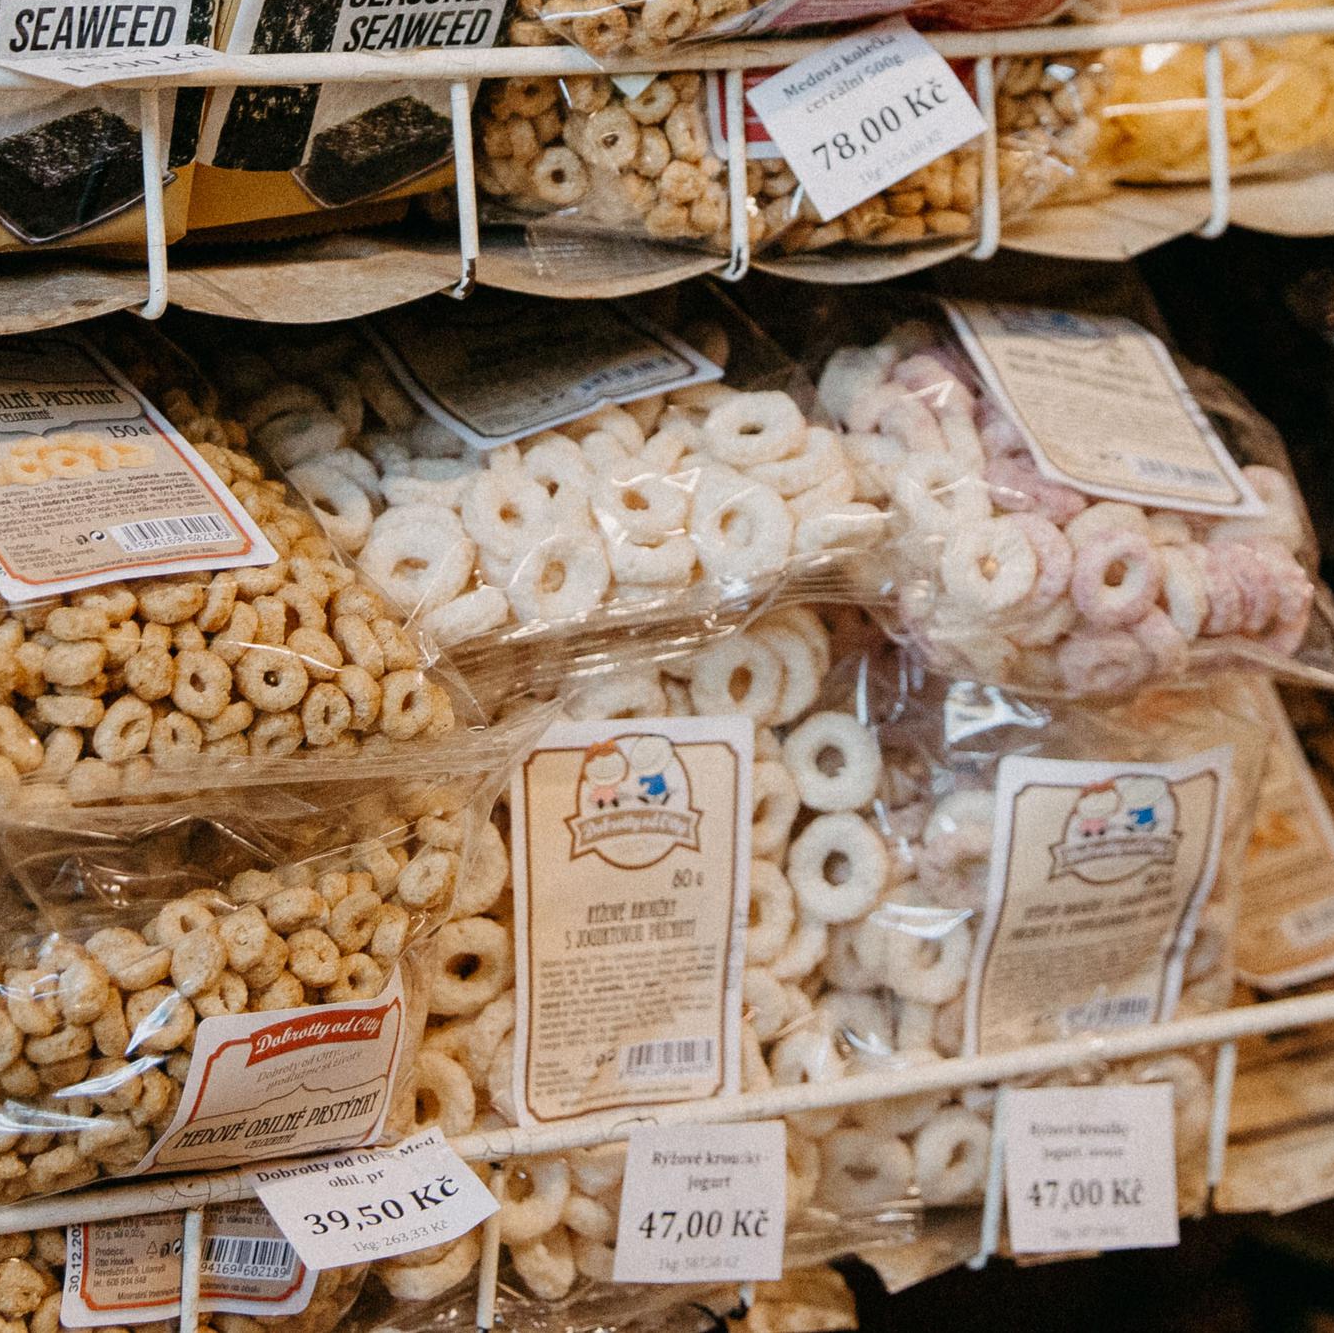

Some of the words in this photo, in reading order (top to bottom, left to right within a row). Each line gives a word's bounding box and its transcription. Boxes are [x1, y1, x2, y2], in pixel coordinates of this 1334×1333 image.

[8, 4, 177, 53] SEAWEED
[342, 7, 493, 53] SEAWEED
[810, 103, 904, 171] 78,00
[904, 76, 950, 118] Kč
[36, 387, 124, 407] PRSTÝNKY
[105, 423, 138, 439] 150
[254, 1021, 333, 1055] Dobrotty
[331, 1020, 351, 1034] od
[172, 1119, 246, 1150] MEDOVÉ
[244, 1106, 306, 1139] OBILNÉ
[303, 1088, 381, 1128] PRSTÝNKY
[255, 1159, 330, 1183] Dobrotty
[333, 1156, 354, 1169] od
[398, 1135, 442, 1157] Med.
[328, 1173, 365, 1189] obil.
[366, 1169, 386, 1185] pr
[1027, 1177, 1104, 1210] 47,00
[1111, 1177, 1145, 1205] Kč
[302, 1198, 405, 1236] 39,50
[408, 1174, 460, 1212] Kč
[382, 1226, 430, 1247] 263,33
[430, 1218, 450, 1233] Kč
[638, 1209, 724, 1243] 47,00
[730, 1208, 769, 1238] Kč
[67, 1221, 84, 1293] 30.12.20
[199, 1262, 239, 1276] 94169
[243, 1265, 288, 1279] 602189
